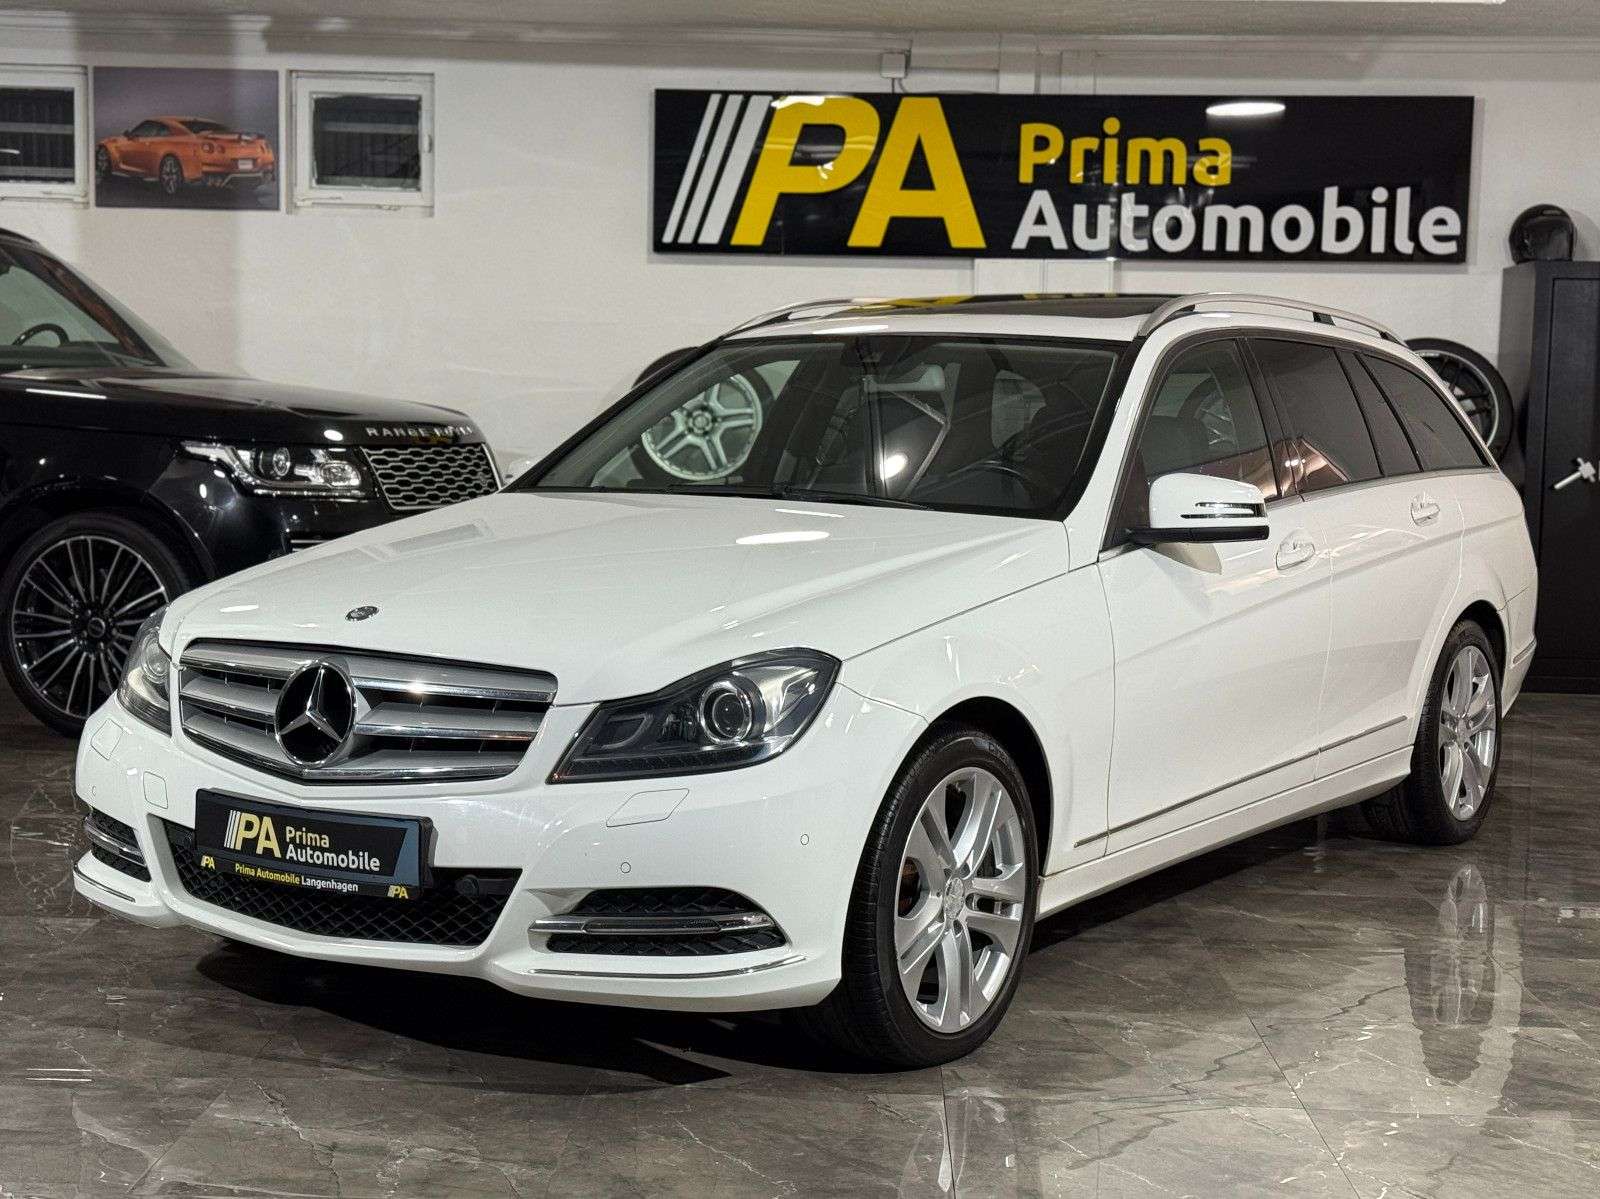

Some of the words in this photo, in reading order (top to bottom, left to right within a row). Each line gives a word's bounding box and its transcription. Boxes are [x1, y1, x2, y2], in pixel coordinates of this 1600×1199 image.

[1018, 117, 1233, 187] Prima
[731, 96, 986, 249] PA
[1011, 185, 1462, 256] Automobile
[366, 426, 430, 437] RANGE
[234, 812, 282, 858] PA
[285, 826, 330, 848] Prima
[202, 855, 216, 870] PA
[285, 843, 381, 872] Automobile
[235, 863, 256, 877] Prima
[256, 868, 300, 885] Automobile
[301, 875, 359, 893] Langenhagen
[391, 885, 409, 900] PA
